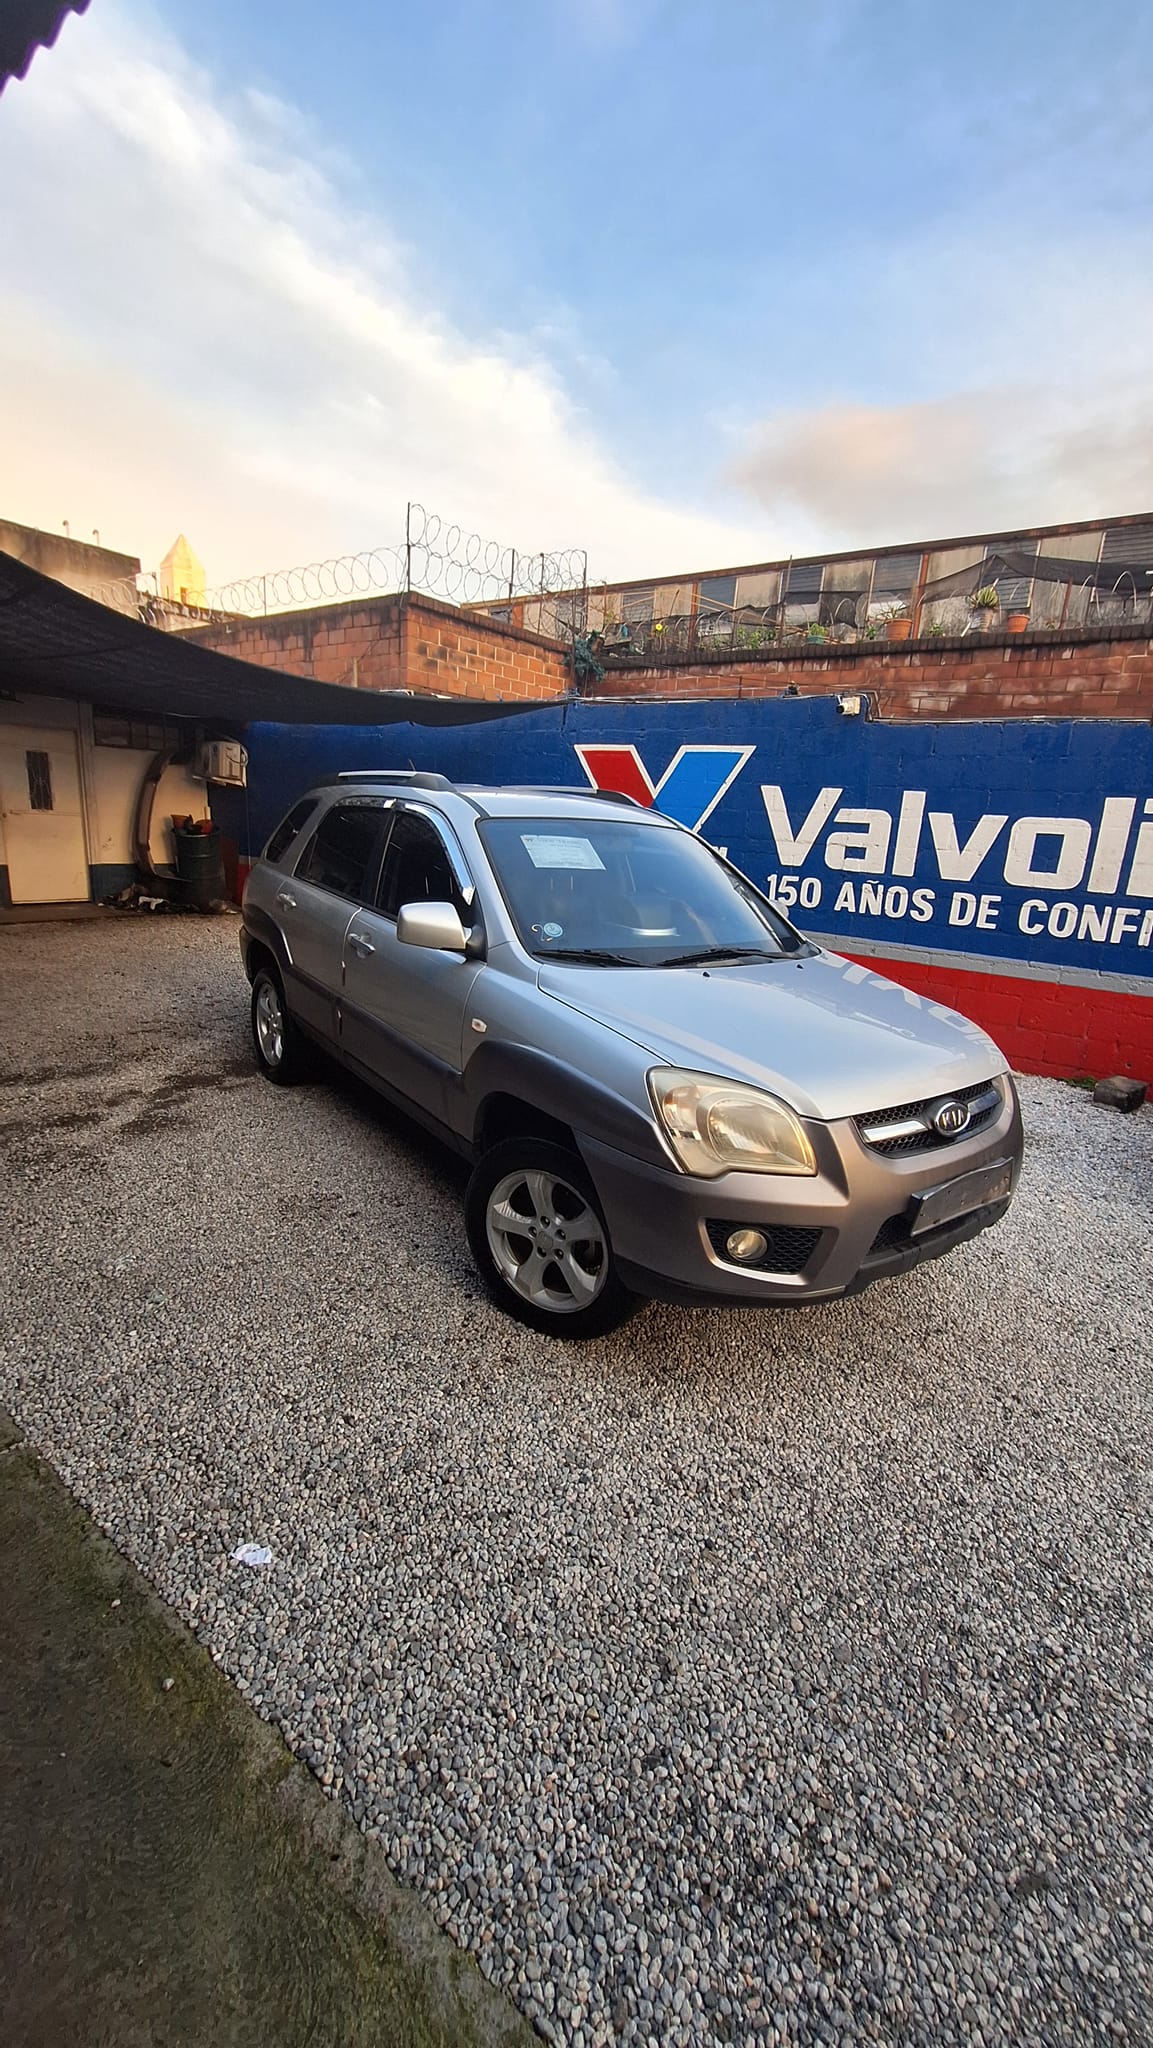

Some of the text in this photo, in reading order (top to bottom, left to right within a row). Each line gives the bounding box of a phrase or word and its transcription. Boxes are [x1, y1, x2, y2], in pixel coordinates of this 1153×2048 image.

[767, 874, 821, 908] 150
[834, 880, 936, 922] AÑOS
[948, 891, 1002, 930] DE
